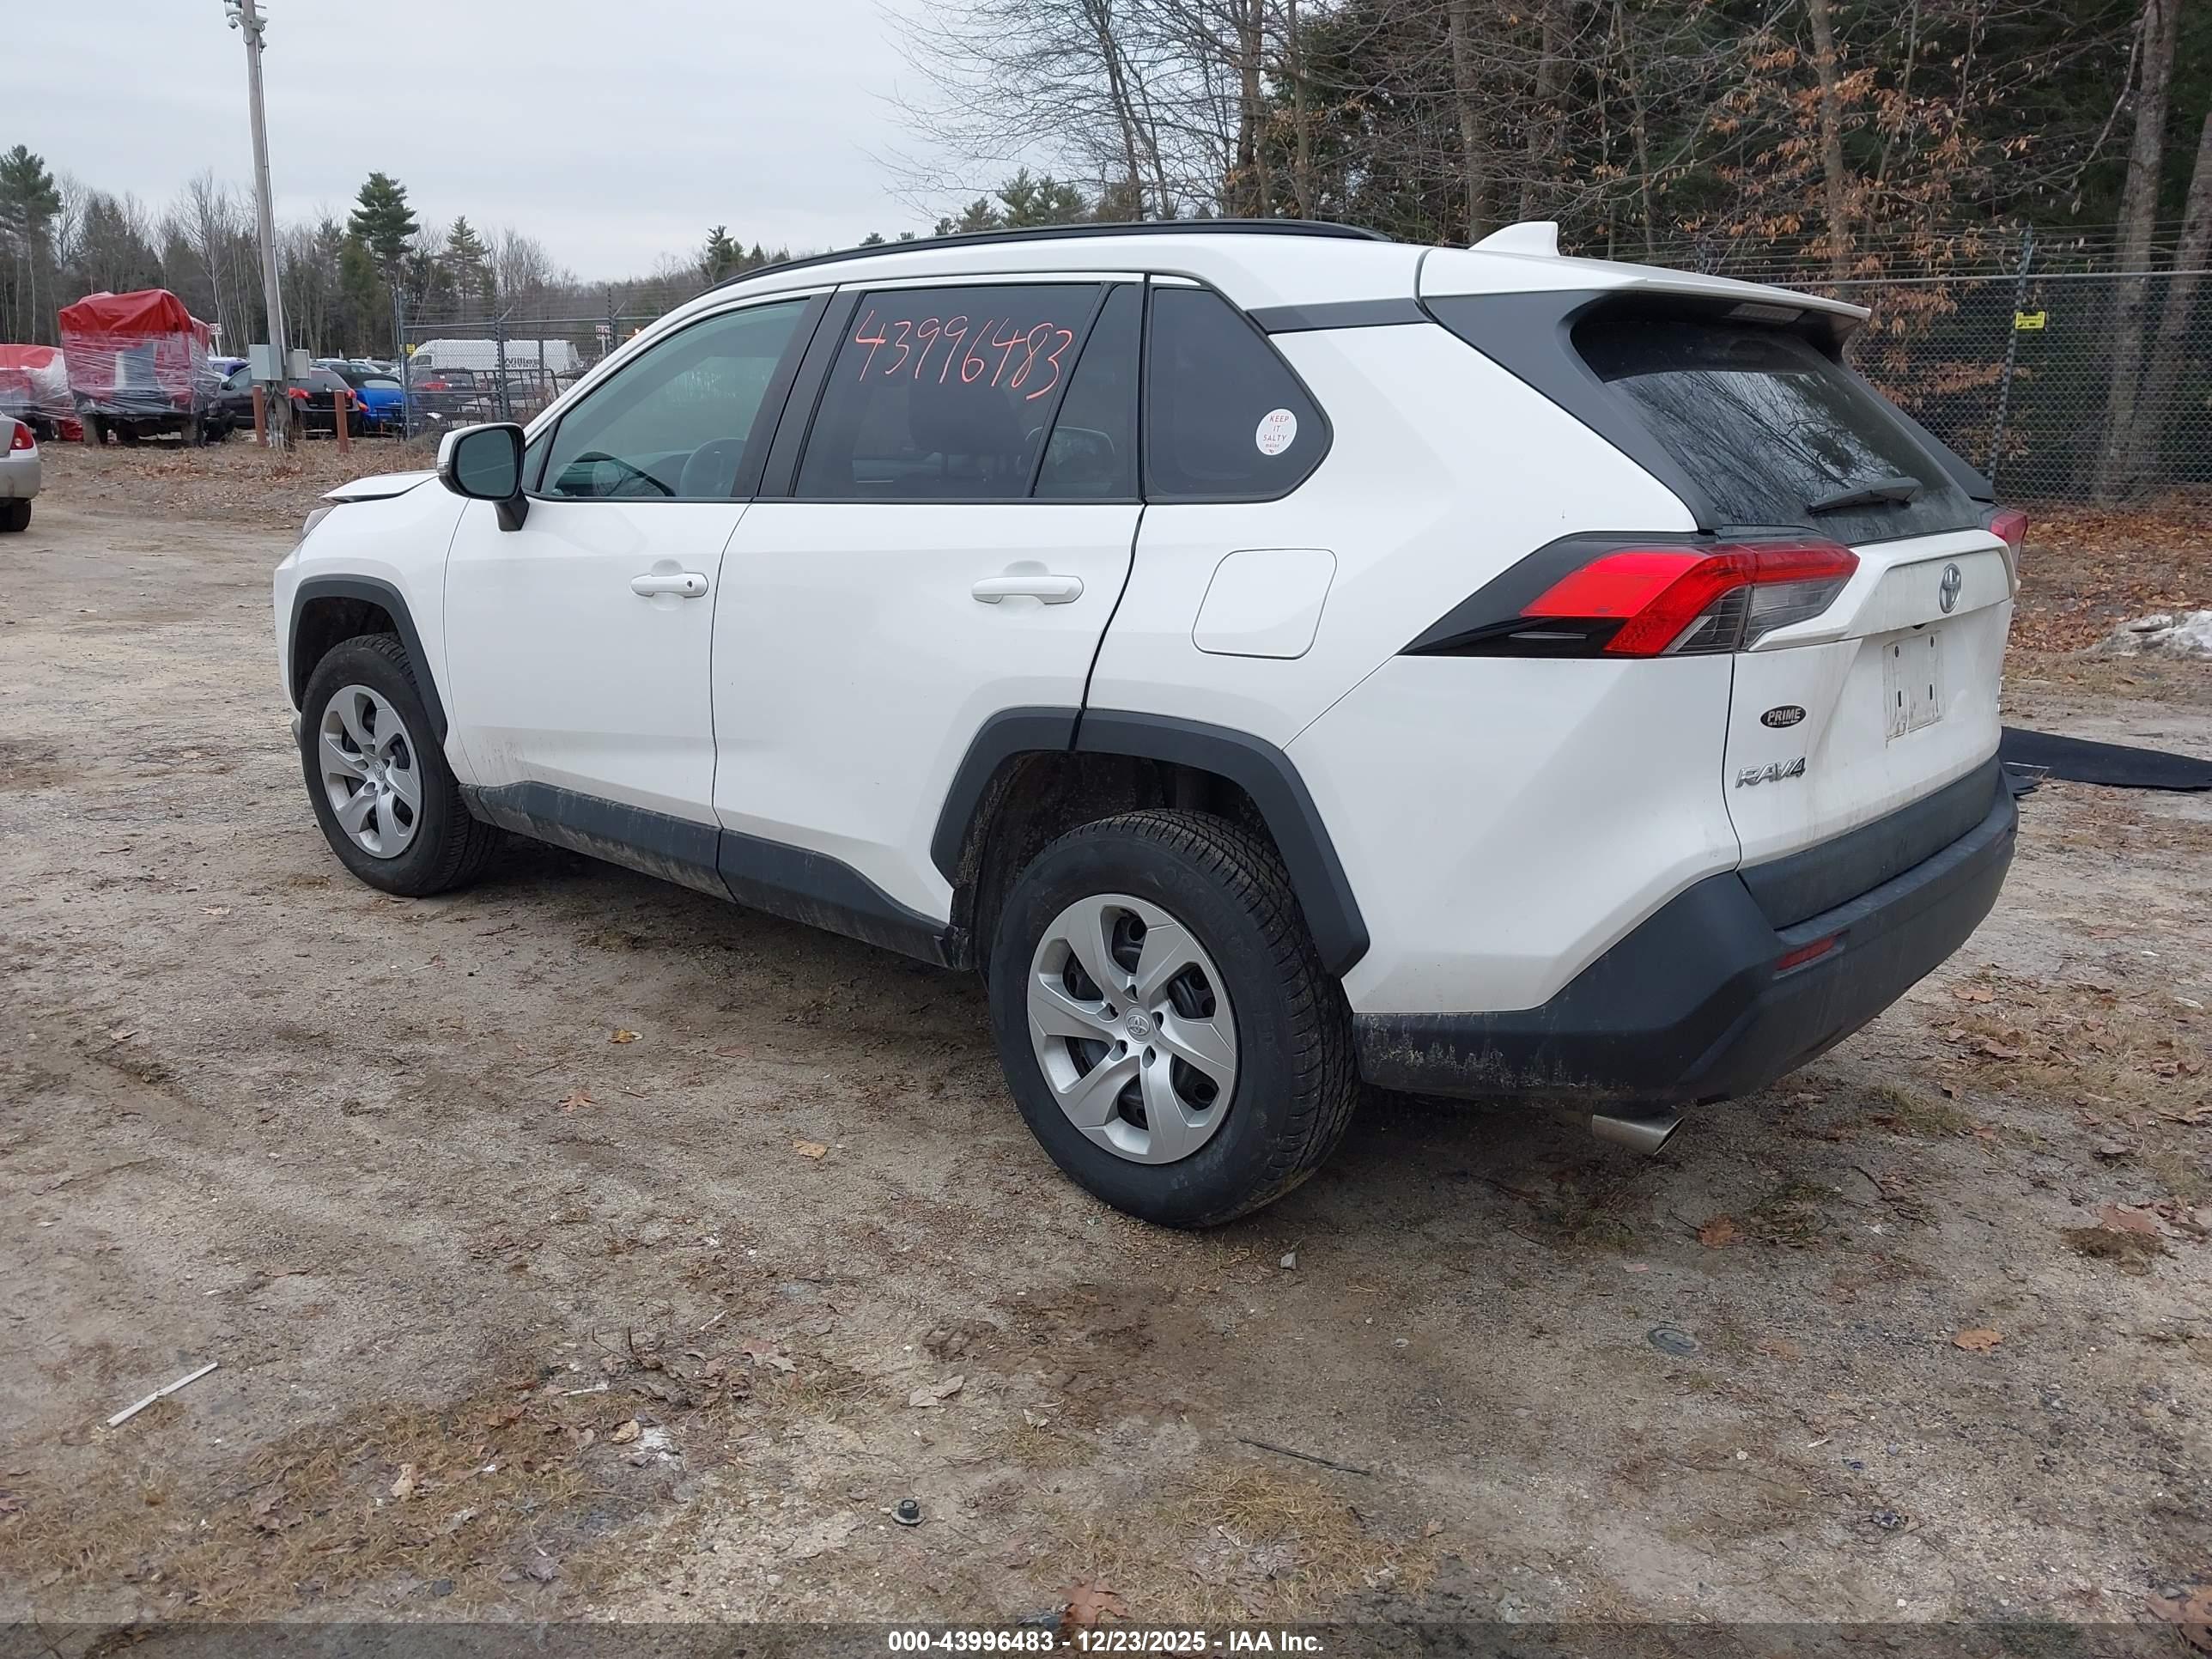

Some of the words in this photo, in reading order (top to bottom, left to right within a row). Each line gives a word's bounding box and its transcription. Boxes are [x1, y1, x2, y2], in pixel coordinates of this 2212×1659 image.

[855, 310, 1073, 400] 43996483
[1767, 708, 1802, 722] PRIME
[1735, 756, 1806, 788] RAV4
